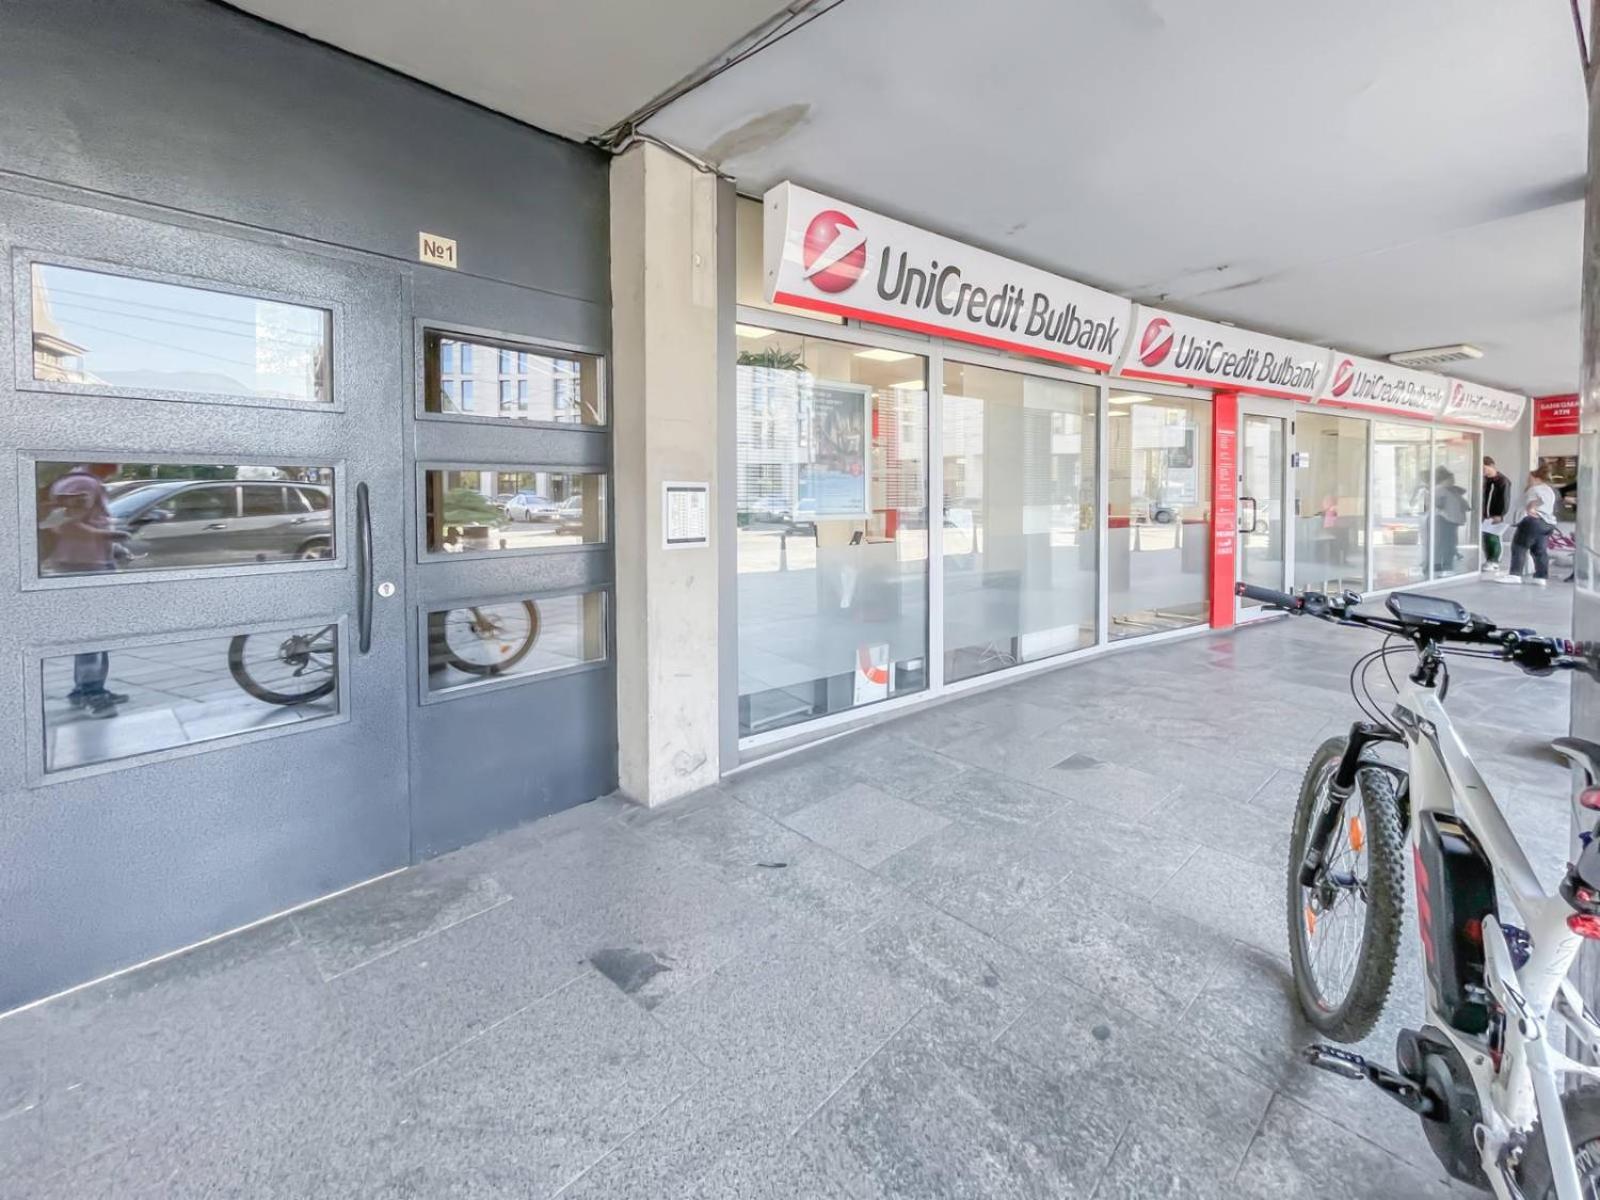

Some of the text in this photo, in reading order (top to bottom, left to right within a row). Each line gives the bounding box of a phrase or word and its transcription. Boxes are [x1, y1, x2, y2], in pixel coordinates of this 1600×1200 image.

[876, 246, 1120, 356] UniCredit Bulbank
[1174, 334, 1320, 389] UniCredit Bulbank
